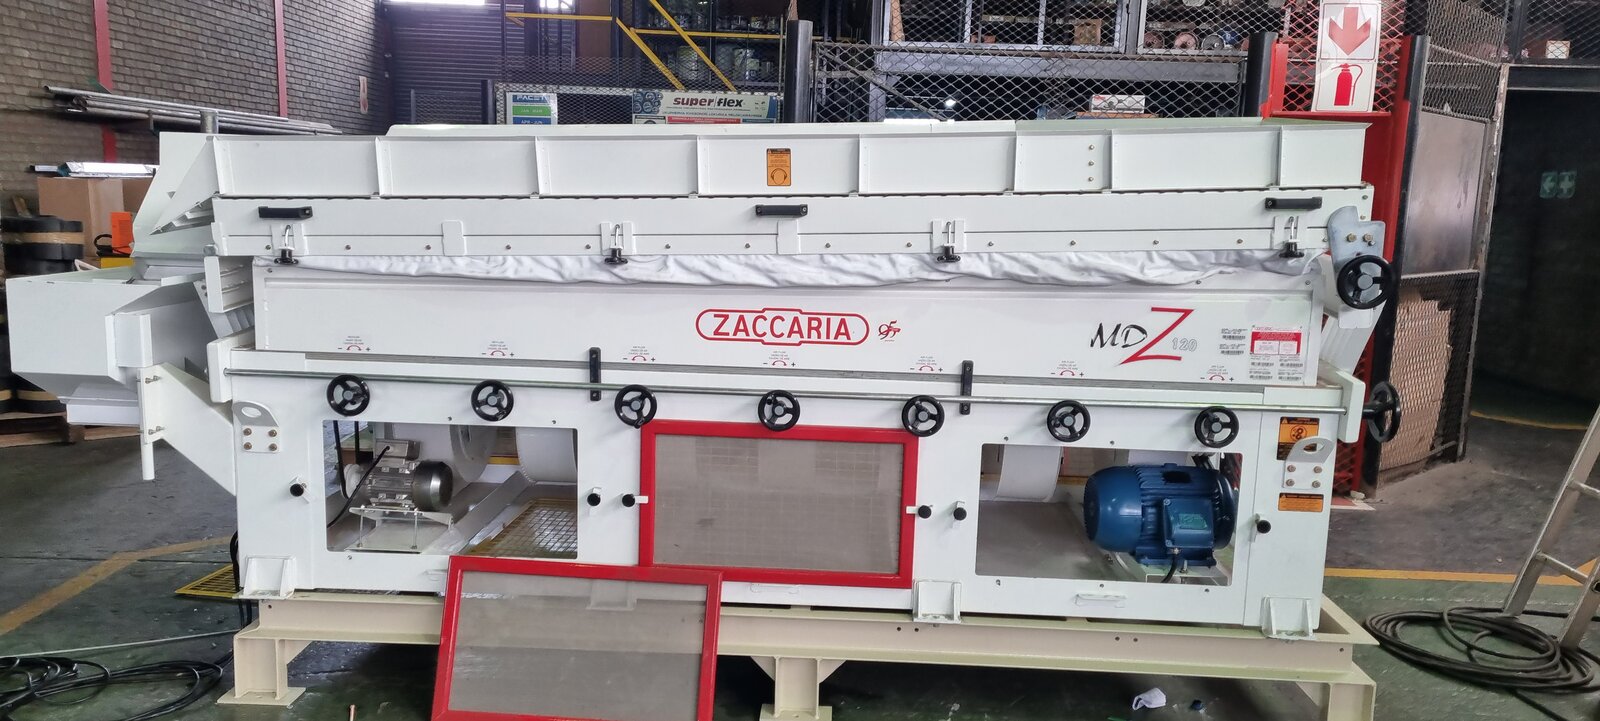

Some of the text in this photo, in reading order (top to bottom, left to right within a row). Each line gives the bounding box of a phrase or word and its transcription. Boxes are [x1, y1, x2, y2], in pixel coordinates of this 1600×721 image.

[672, 96, 744, 108] super flex
[713, 313, 851, 341] ZACCARIA
[1172, 337, 1198, 352] 120
